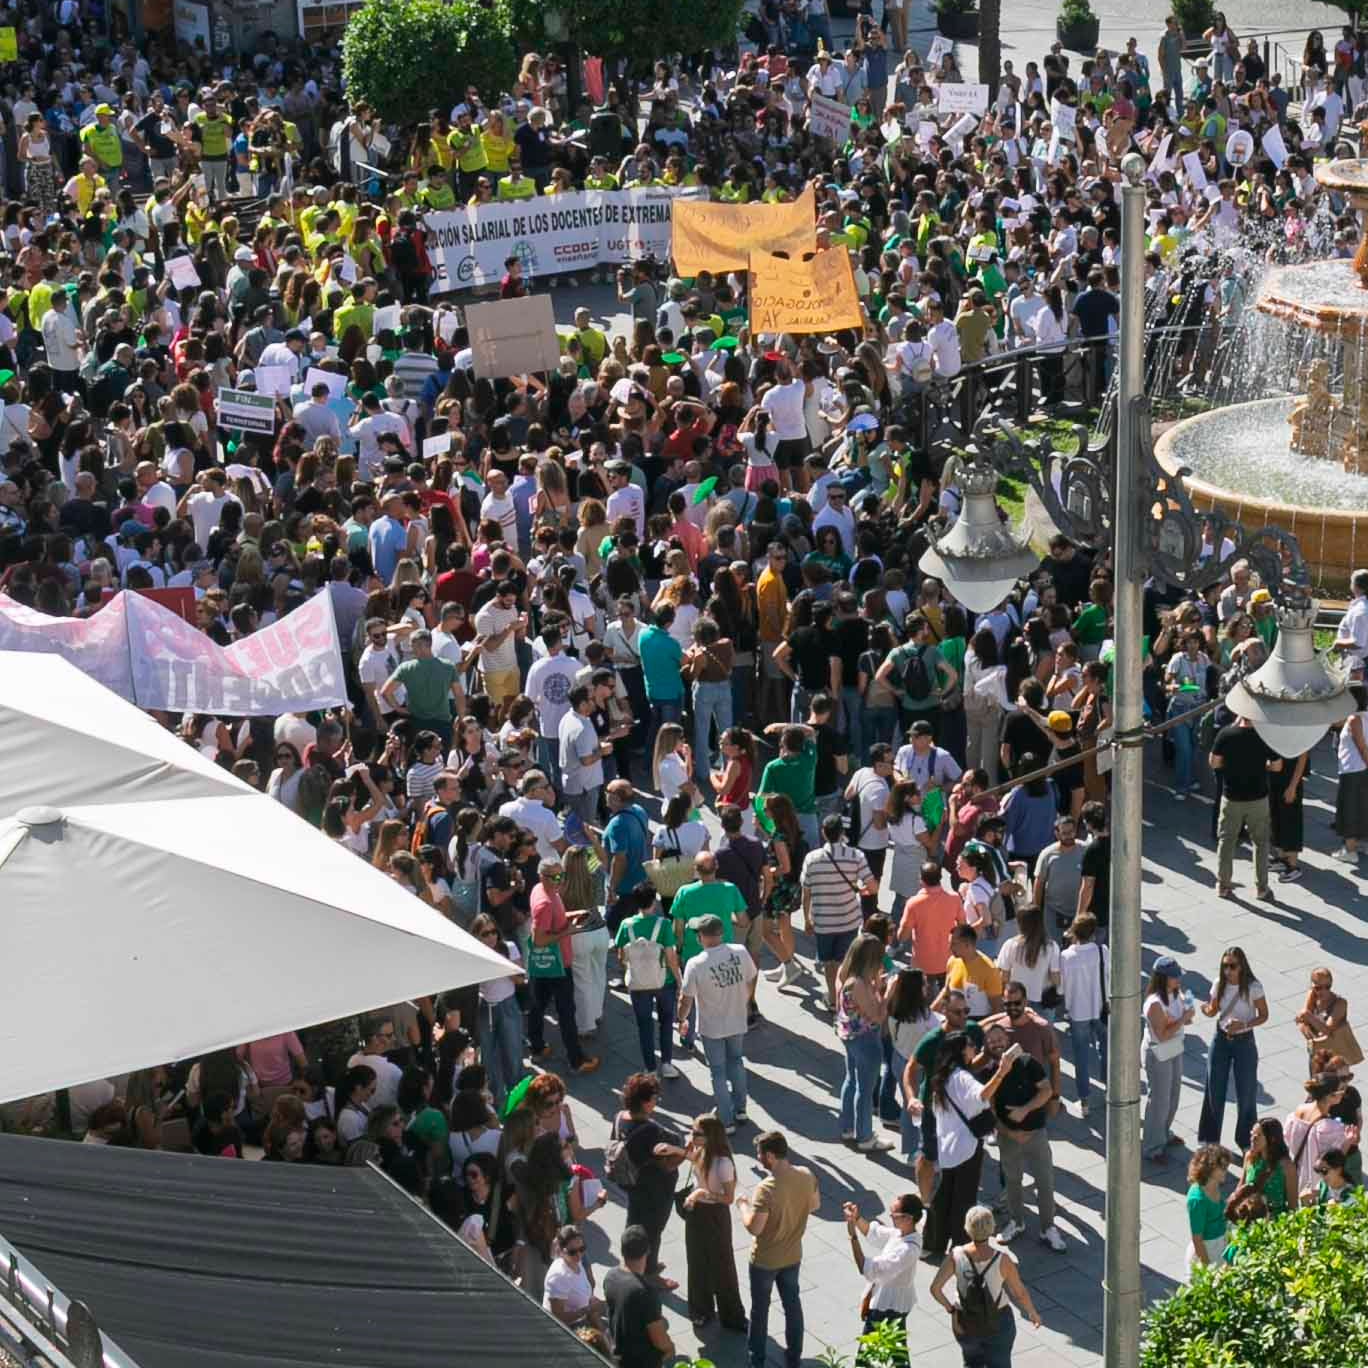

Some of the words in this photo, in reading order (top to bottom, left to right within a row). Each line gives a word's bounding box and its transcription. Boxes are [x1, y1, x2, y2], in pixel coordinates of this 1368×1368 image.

[462, 218, 511, 244] SALARIAL
[513, 216, 527, 236] DE
[529, 212, 549, 234] LOS
[552, 205, 603, 232] DOCENTES
[605, 204, 619, 223] DE
[607, 240, 630, 251] UGT
